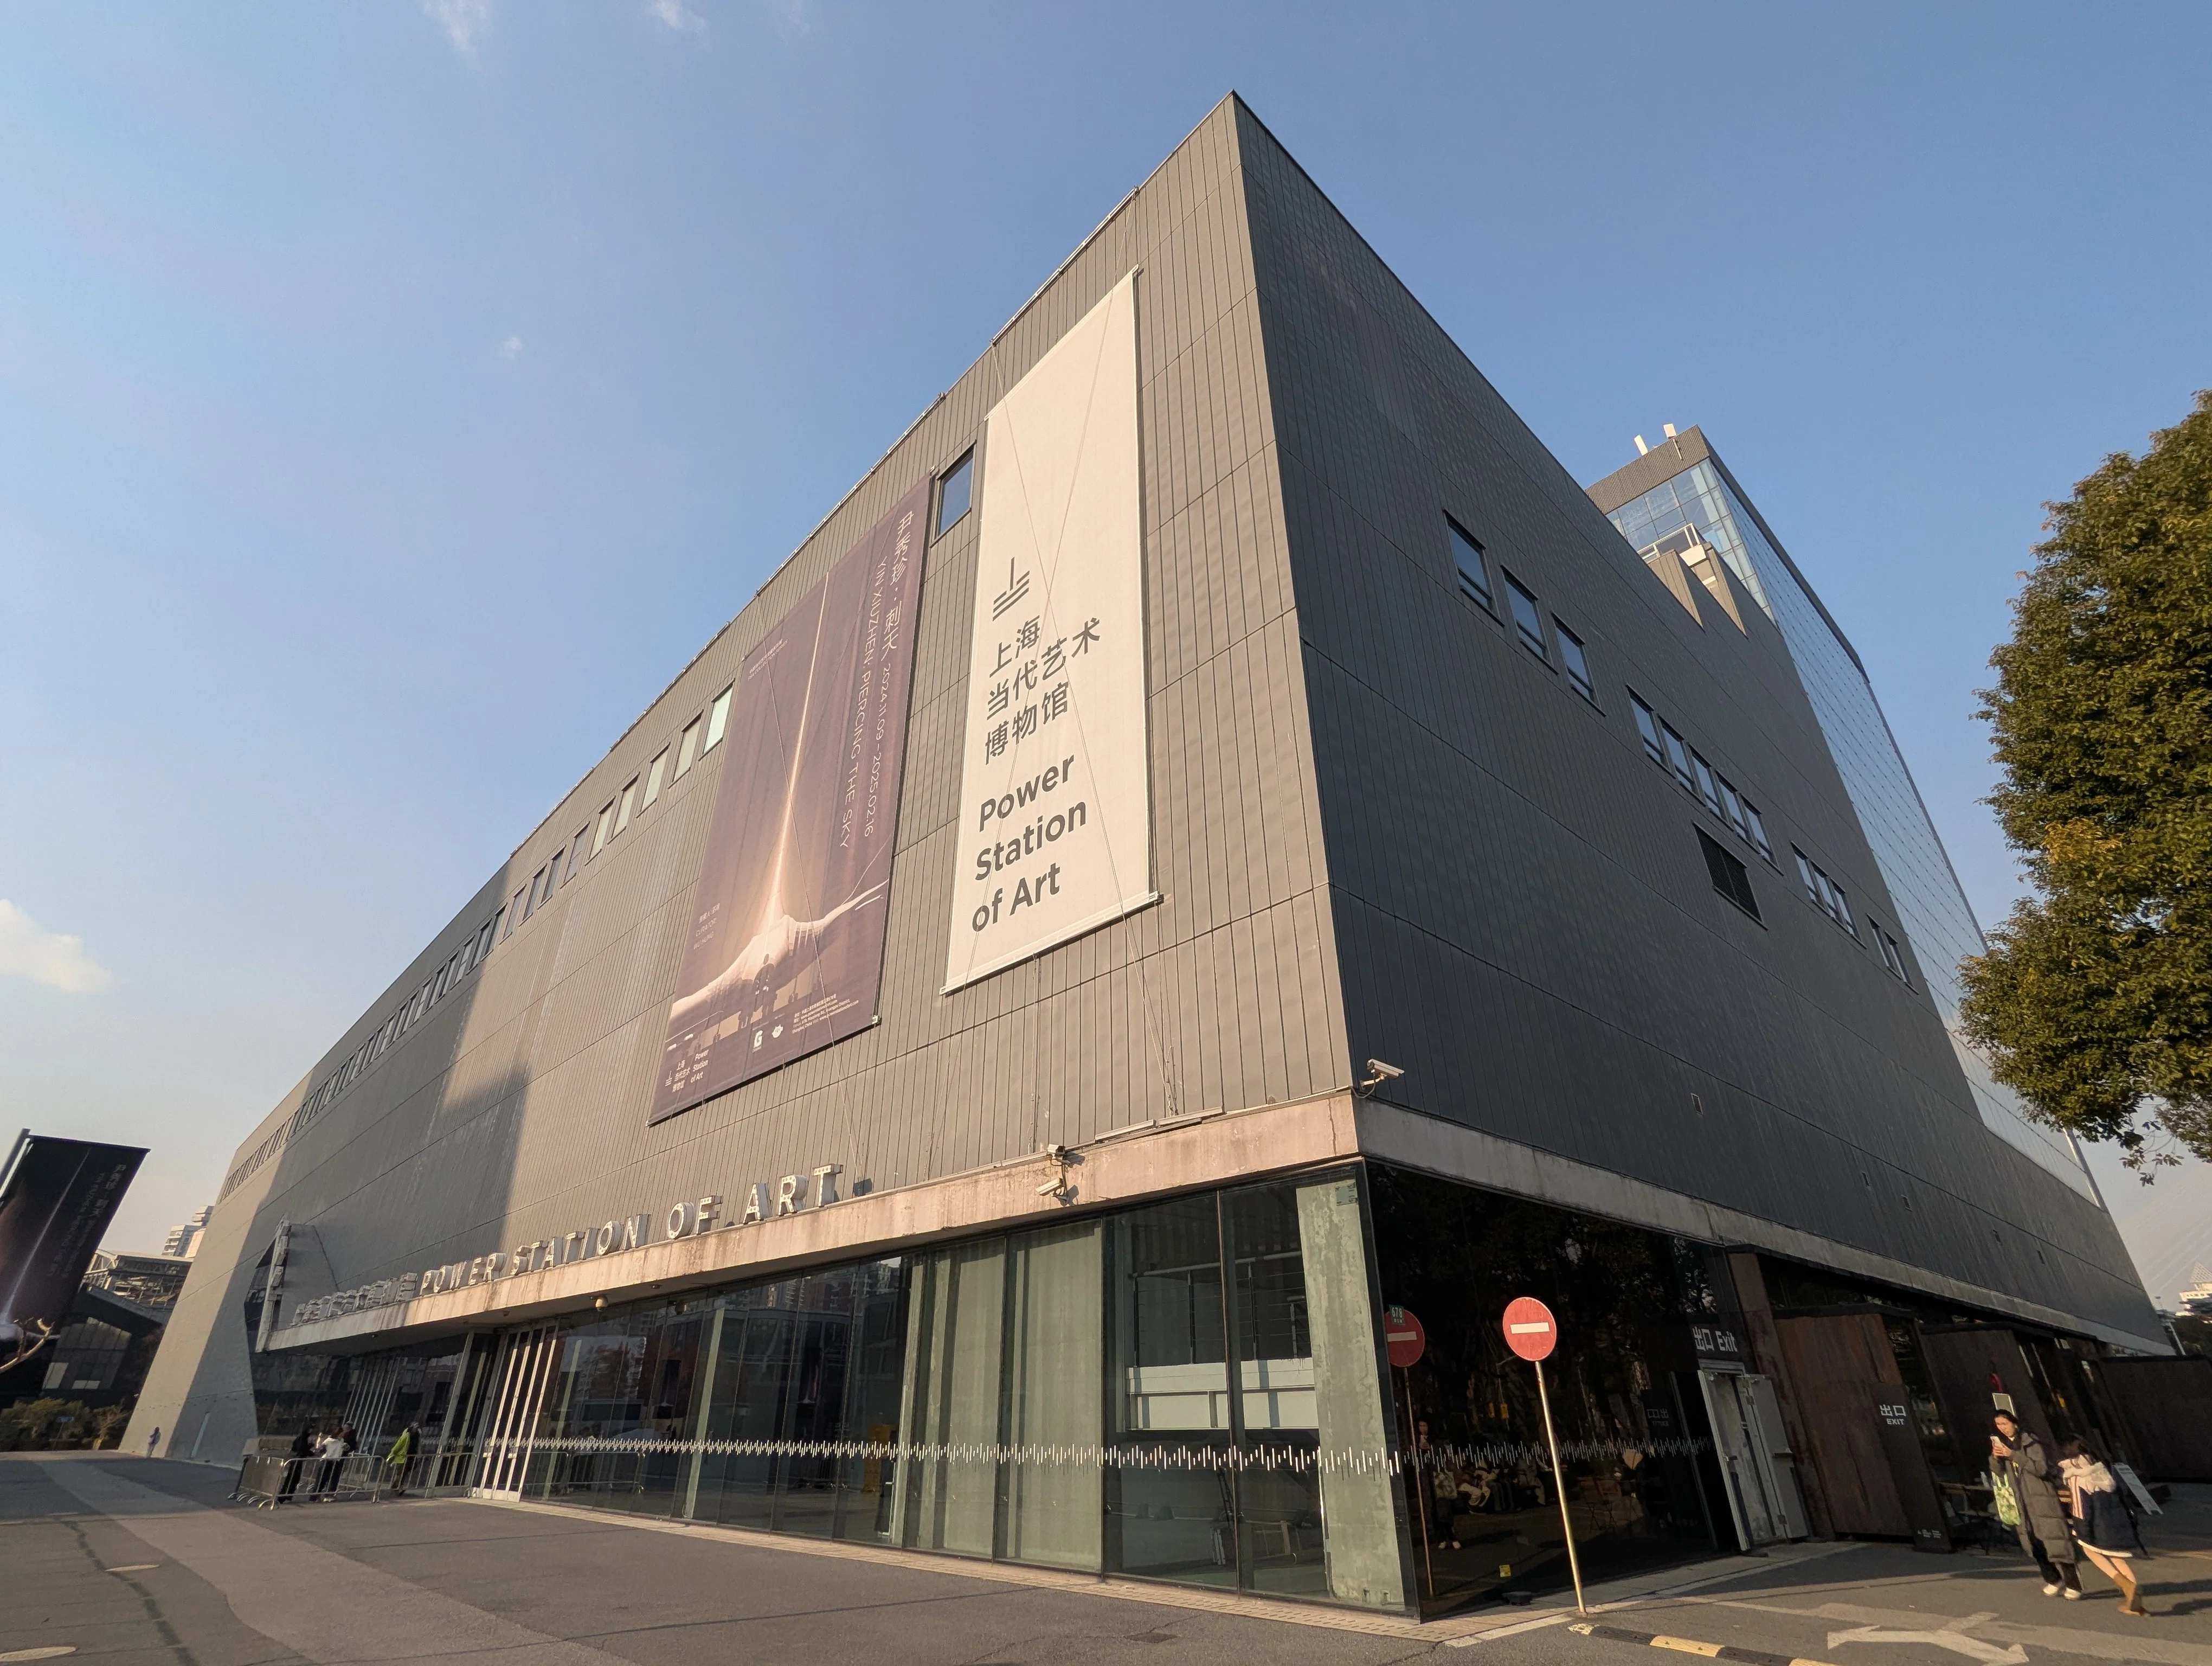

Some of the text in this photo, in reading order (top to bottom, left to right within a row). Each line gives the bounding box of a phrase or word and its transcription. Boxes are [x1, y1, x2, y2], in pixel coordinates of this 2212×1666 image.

[987, 617, 1101, 720] 当代艺术
[989, 615, 1040, 677] 上海
[840, 556, 888, 848] YIN XIUZHEN: PIERCING THE SKY
[985, 681, 1070, 765] 博物馆
[979, 755, 1075, 832] Power
[975, 802, 1086, 881] Station
[972, 863, 1061, 932] of Art
[420, 1163, 844, 1296] POWER STATION OF ART
[1391, 1306, 1403, 1318] 678
[1692, 1326, 1738, 1352] 出口 Exit
[1879, 1404, 1906, 1417] 出口
